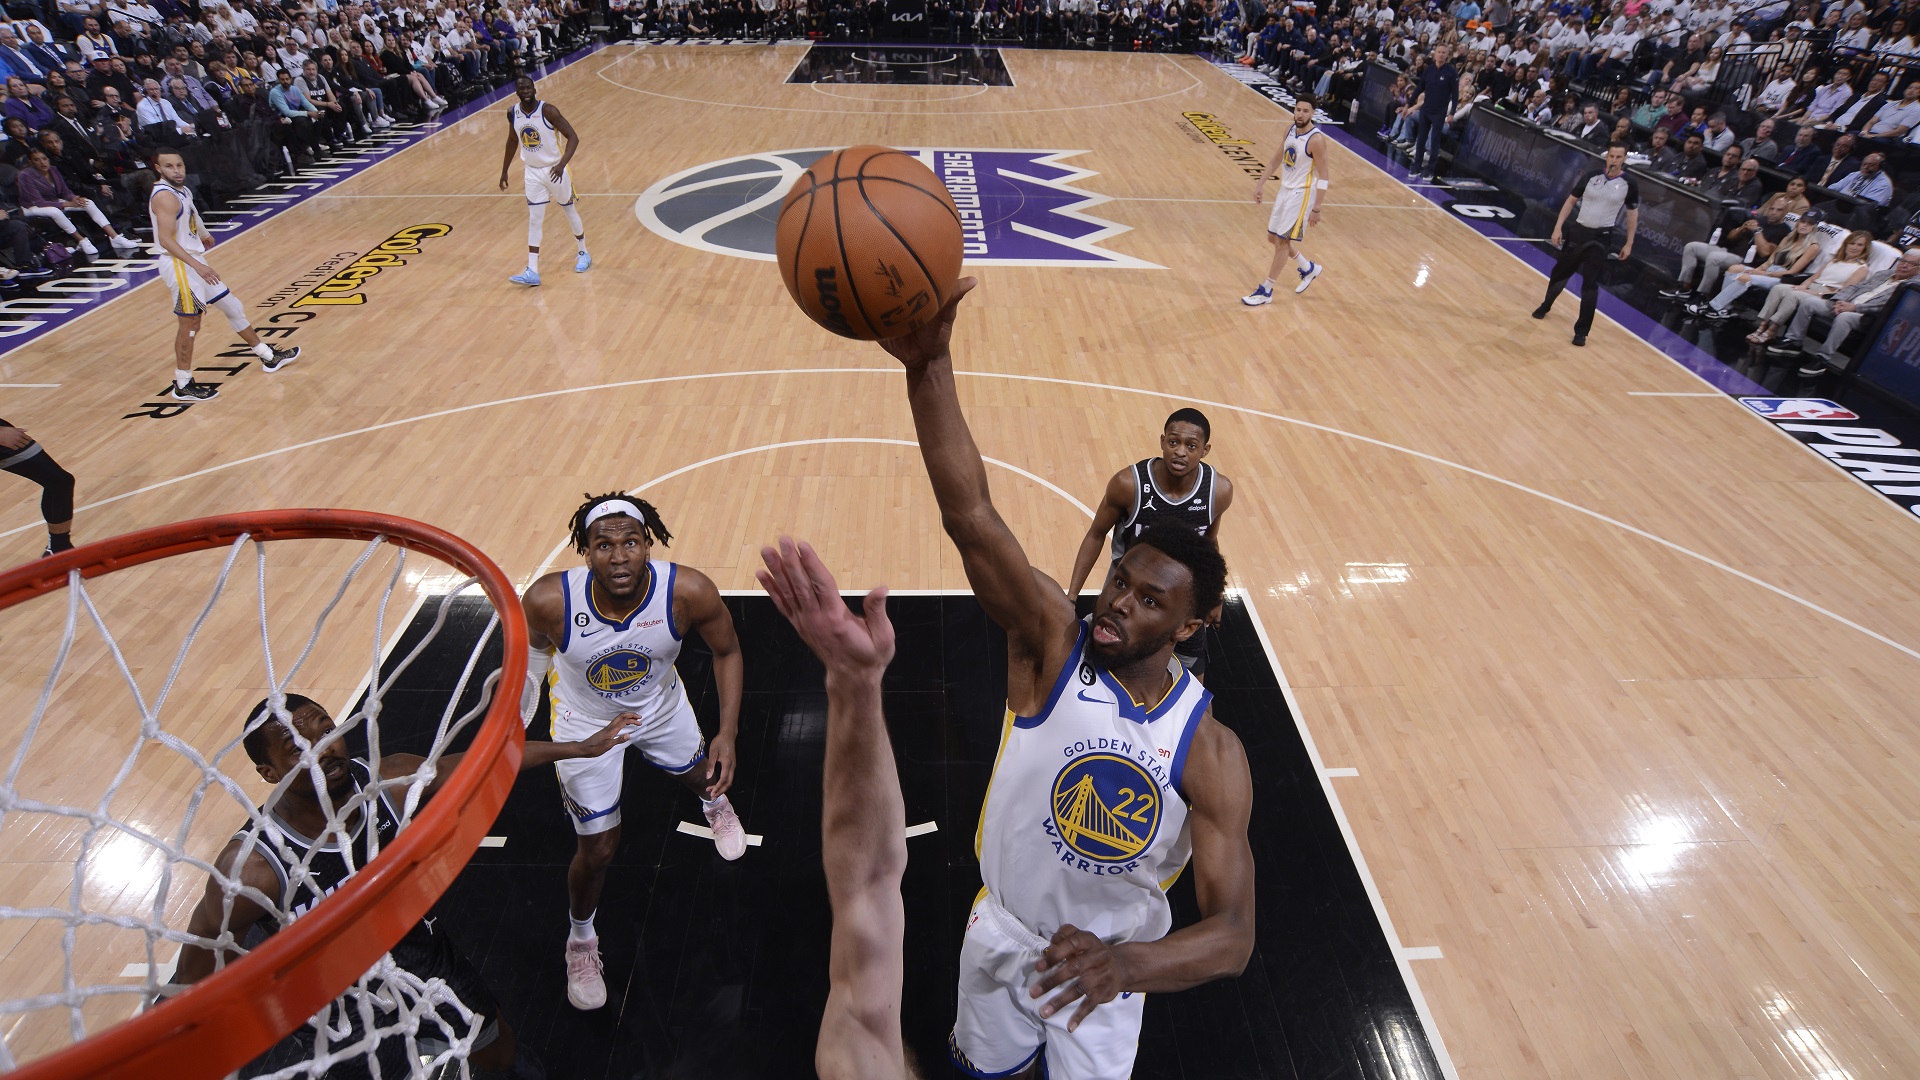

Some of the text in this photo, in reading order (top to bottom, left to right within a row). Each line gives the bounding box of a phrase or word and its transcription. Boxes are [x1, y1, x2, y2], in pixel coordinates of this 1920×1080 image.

[891, 12, 923, 22] KIA
[1261, 86, 1297, 107] Goog
[943, 152, 988, 255] SACRAMENTO
[0, 242, 160, 338] ROUD
[256, 251, 358, 309] Credit Union
[1143, 483, 1151, 494] 6
[1187, 504, 1207, 512] dialpad
[577, 613, 588, 625] 6
[636, 618, 664, 629] Rakuten
[585, 642, 653, 664] GOLDEN STATE
[627, 657, 638, 669] 5
[1080, 665, 1093, 684] 6
[1063, 737, 1172, 792] GOLDEN STATE
[1111, 787, 1154, 824] 22
[1042, 815, 1149, 876] WARRIOR
